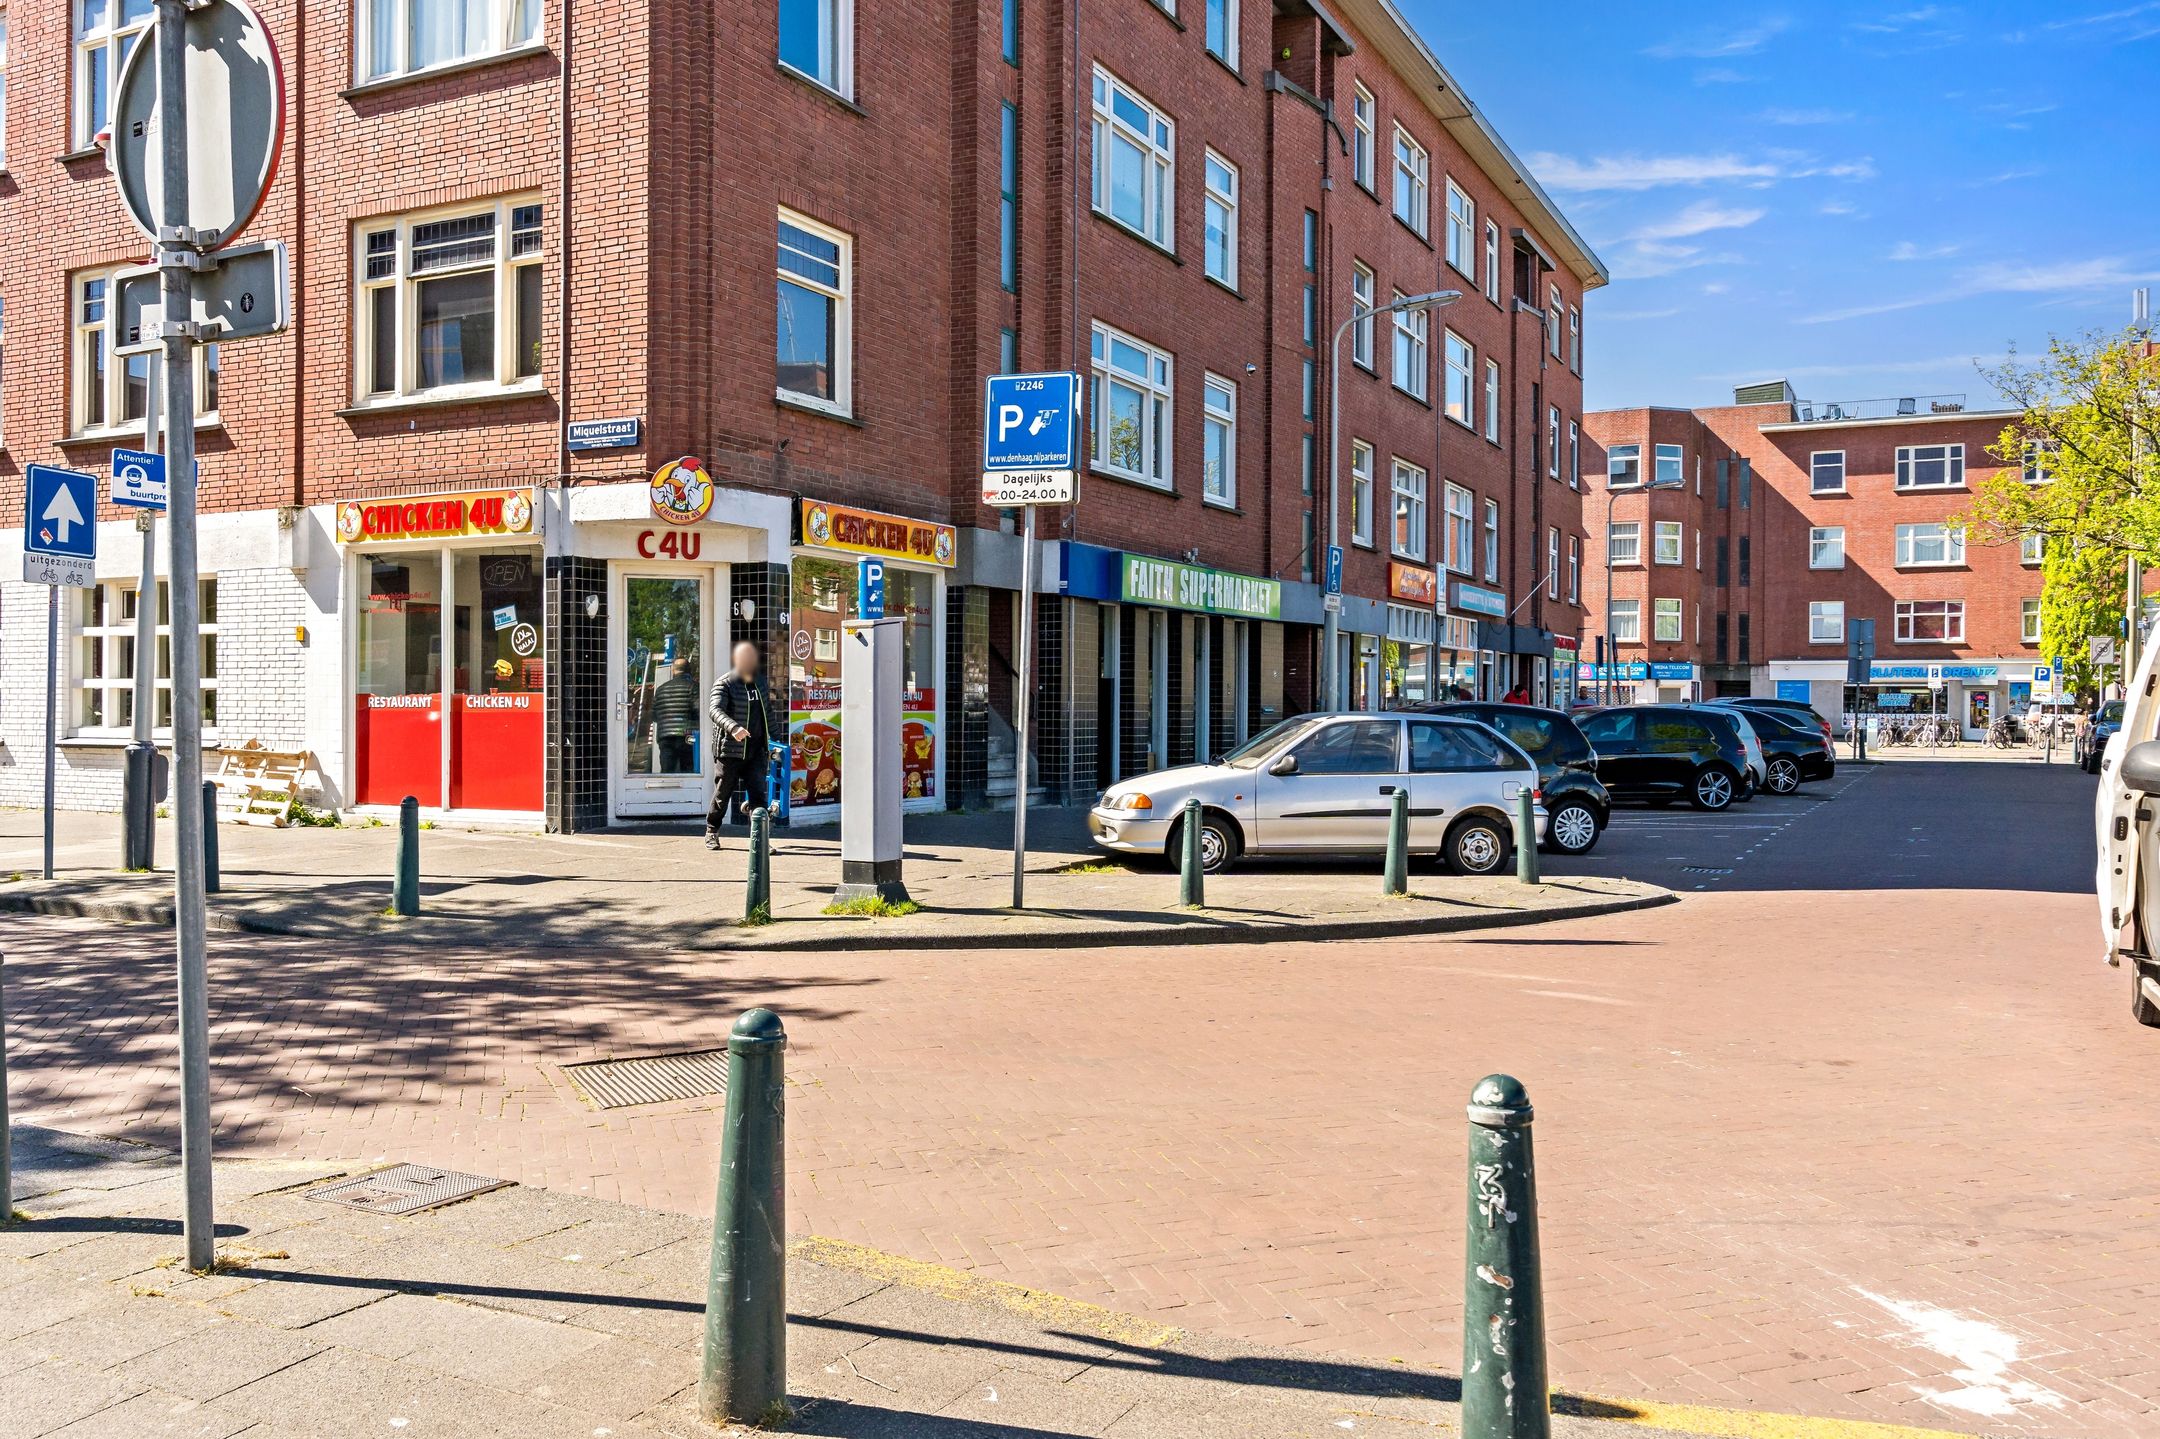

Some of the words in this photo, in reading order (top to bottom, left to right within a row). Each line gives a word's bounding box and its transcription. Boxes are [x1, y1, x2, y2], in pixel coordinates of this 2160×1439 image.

[1020, 380, 1044, 391] 2246
[999, 405, 1024, 442] P
[573, 423, 632, 438] Miquelstraat
[117, 453, 154, 465] Attentie!
[1003, 474, 1053, 486] Dagelijks
[997, 489, 1056, 501] .00-24.00
[1060, 489, 1067, 499] h
[362, 500, 464, 535] CHICKEN
[469, 497, 505, 528] 4U
[659, 506, 690, 520] CHICKEN
[691, 511, 701, 519] 4U
[833, 513, 908, 552] CHICKEN
[910, 528, 933, 556] 4U
[30, 556, 93, 570] uitgezonderd
[1332, 550, 1340, 574] P
[484, 566, 526, 581] OPEN
[867, 565, 883, 587] P
[1131, 560, 1174, 602] FAITH
[1180, 569, 1272, 614] SUPERMARKET
[517, 638, 535, 651] HALAL
[2055, 657, 2061, 667] P
[1941, 667, 1997, 679] ORENTZ
[2038, 668, 2048, 680] P
[369, 696, 432, 708] RESTAURANT
[466, 696, 512, 708] CHICKEN
[514, 697, 529, 708] 4U
